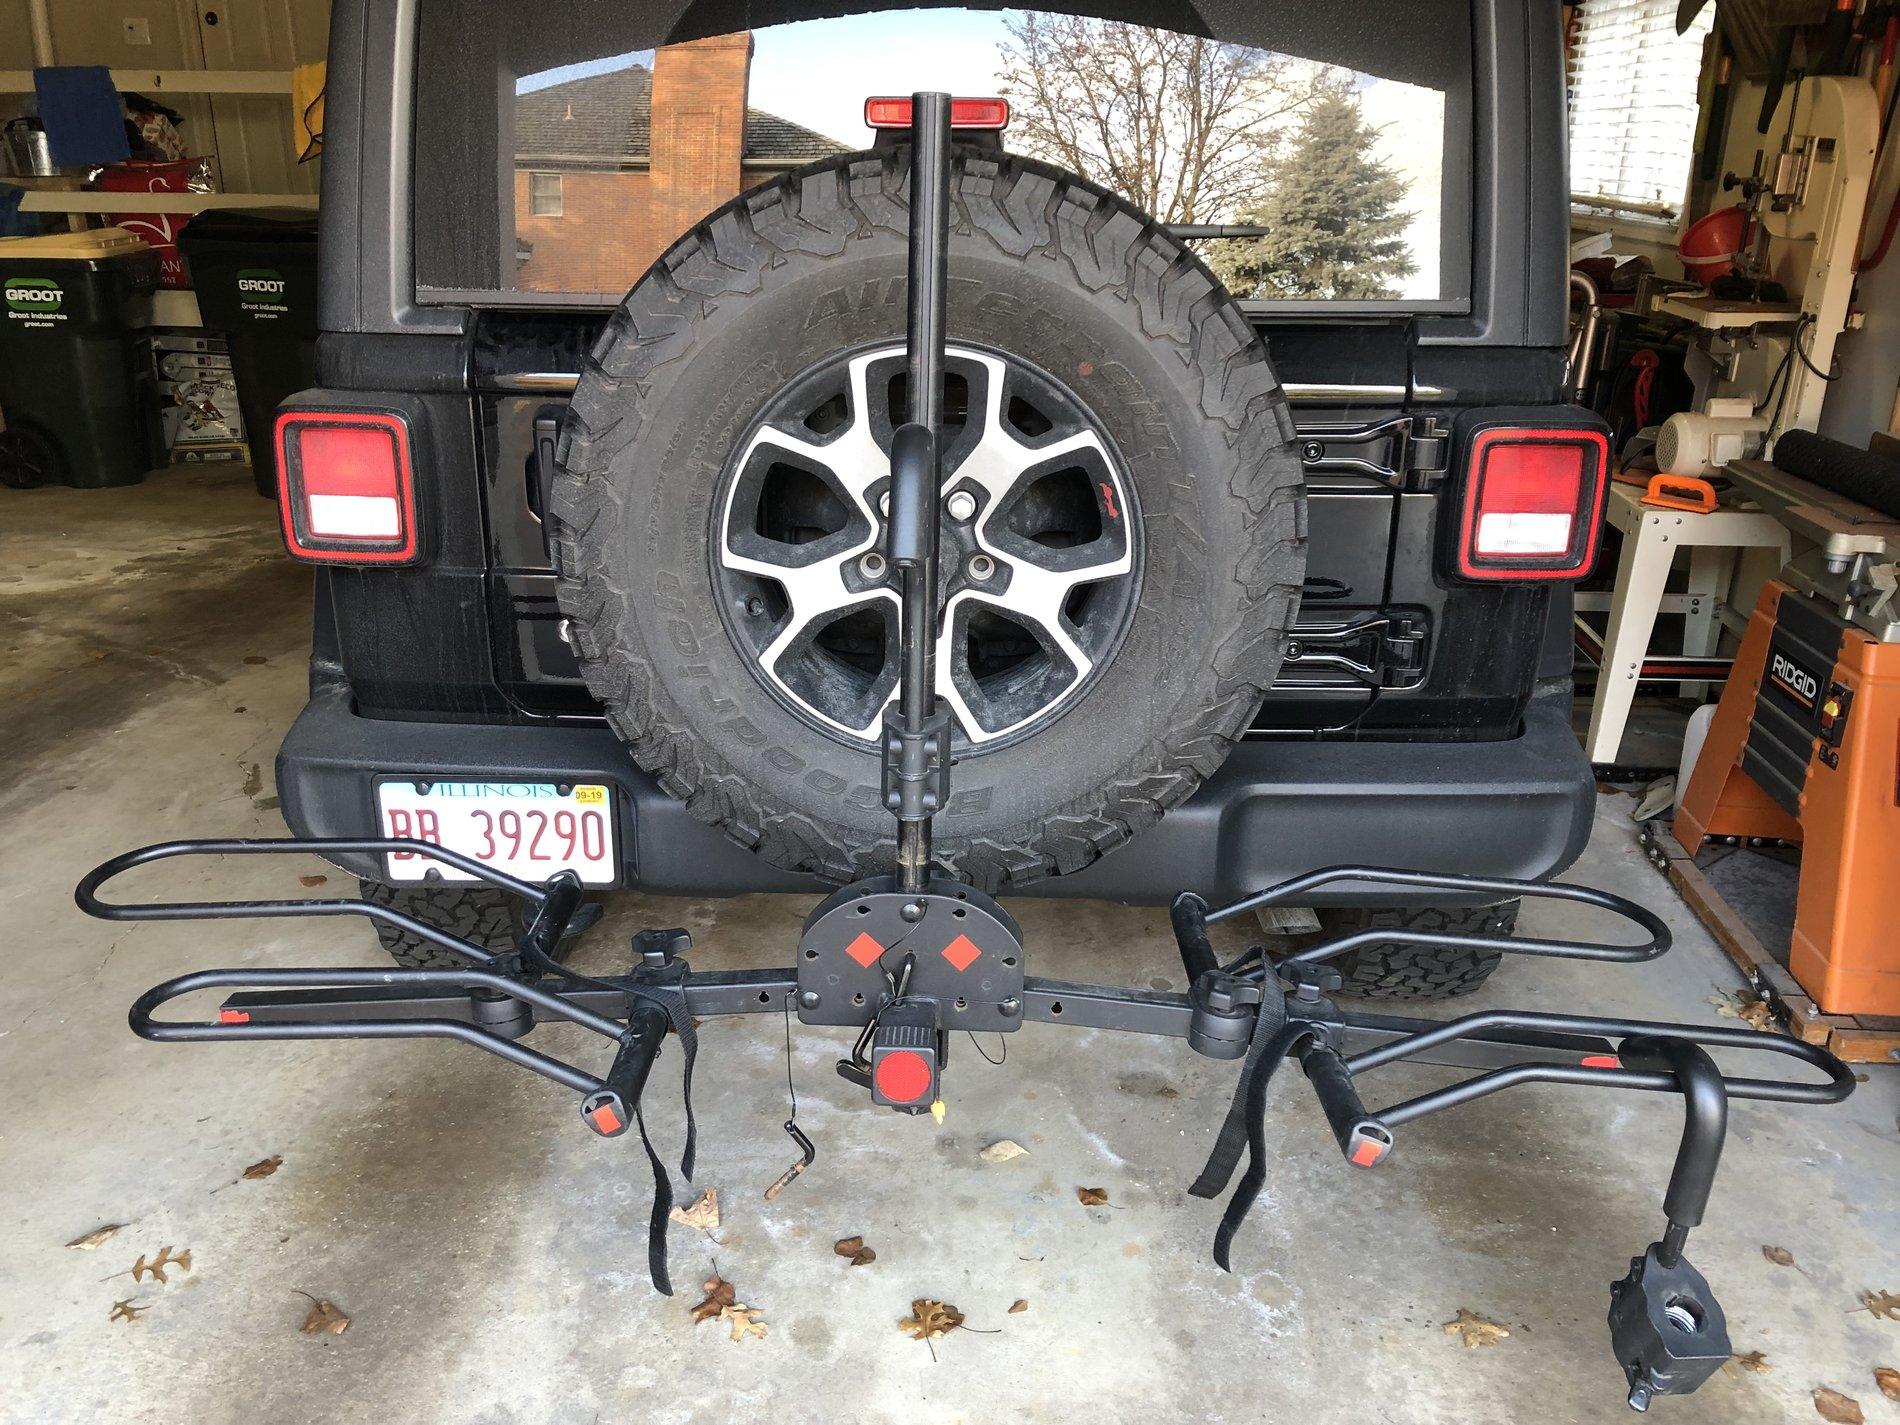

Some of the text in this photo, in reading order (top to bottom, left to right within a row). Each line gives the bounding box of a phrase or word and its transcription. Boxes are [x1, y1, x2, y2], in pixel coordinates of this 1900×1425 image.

[238, 279, 285, 293] GROOT
[5, 288, 64, 302] GROOT
[241, 302, 289, 312] Groot Industries
[8, 311, 68, 320] Groot Industries
[1772, 653, 1817, 699] RIDGID
[440, 783, 553, 798] ILLINOIS
[575, 791, 602, 800] 09-19
[470, 809, 605, 861] 39290
